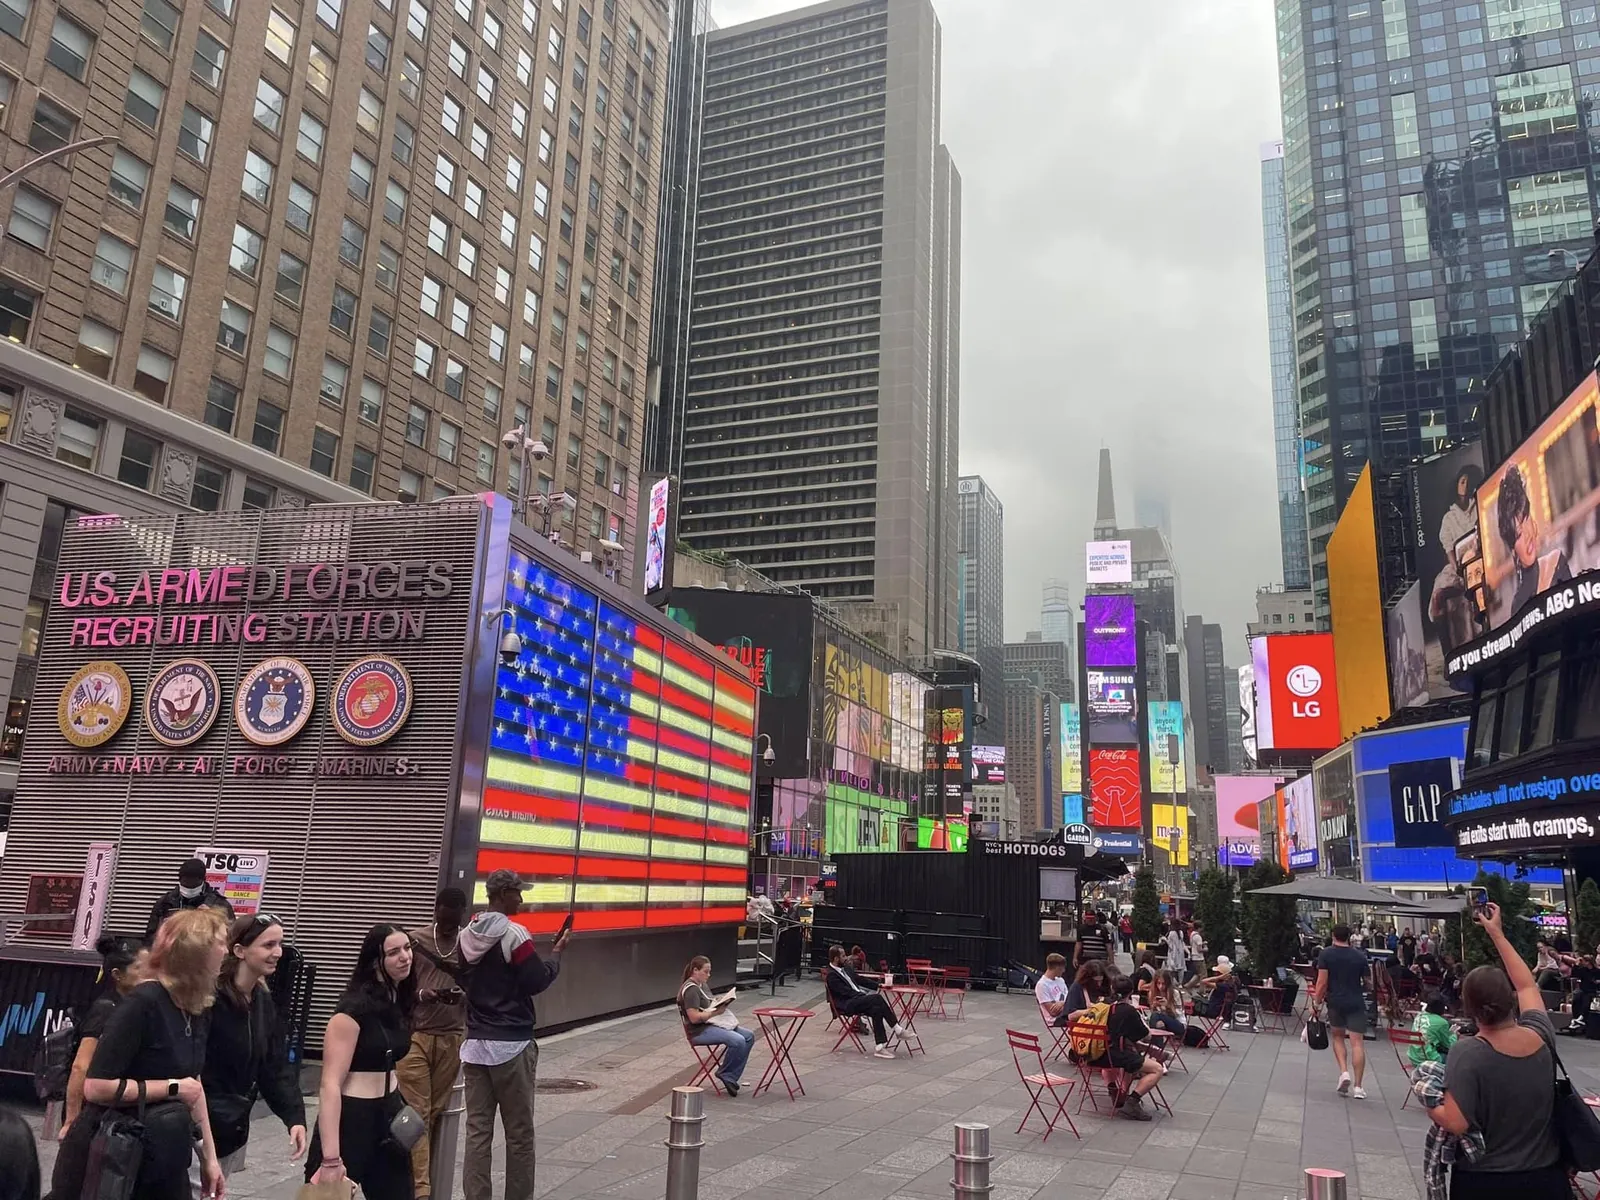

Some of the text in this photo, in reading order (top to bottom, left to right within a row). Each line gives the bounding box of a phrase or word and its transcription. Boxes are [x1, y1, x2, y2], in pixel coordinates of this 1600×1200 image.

[60, 561, 455, 608] U.S. ARMED FORCES
[69, 610, 425, 646] RECRUITING STATION
[1461, 648, 1480, 671] you
[1481, 632, 1511, 659] stream
[1546, 588, 1575, 617] ABC
[152, 667, 184, 701] DEPARTMENT
[204, 678, 214, 697] NAVY
[338, 663, 376, 701] DEPARTMENT
[394, 673, 406, 695] NAVY
[337, 707, 352, 730] UNITED
[351, 727, 371, 737] STATES
[371, 721, 394, 736] MARINE
[1155, 718, 1176, 727] anyone
[1292, 701, 1321, 718] LG
[47, 755, 100, 773] ARMY
[112, 755, 171, 774] NAVY
[318, 756, 409, 775] MARINES
[1509, 782, 1524, 802] not
[1526, 776, 1566, 800] resign
[1403, 784, 1440, 823] GAP
[1067, 834, 1090, 842] GARDEN
[1071, 825, 1085, 833] BEER
[1321, 814, 1348, 841] OLD NAVY
[1488, 821, 1507, 841] start
[1508, 818, 1531, 839] with
[1533, 817, 1594, 839] cramps,
[204, 853, 239, 872] TSQ
[1004, 844, 1066, 857] HOTDOGS
